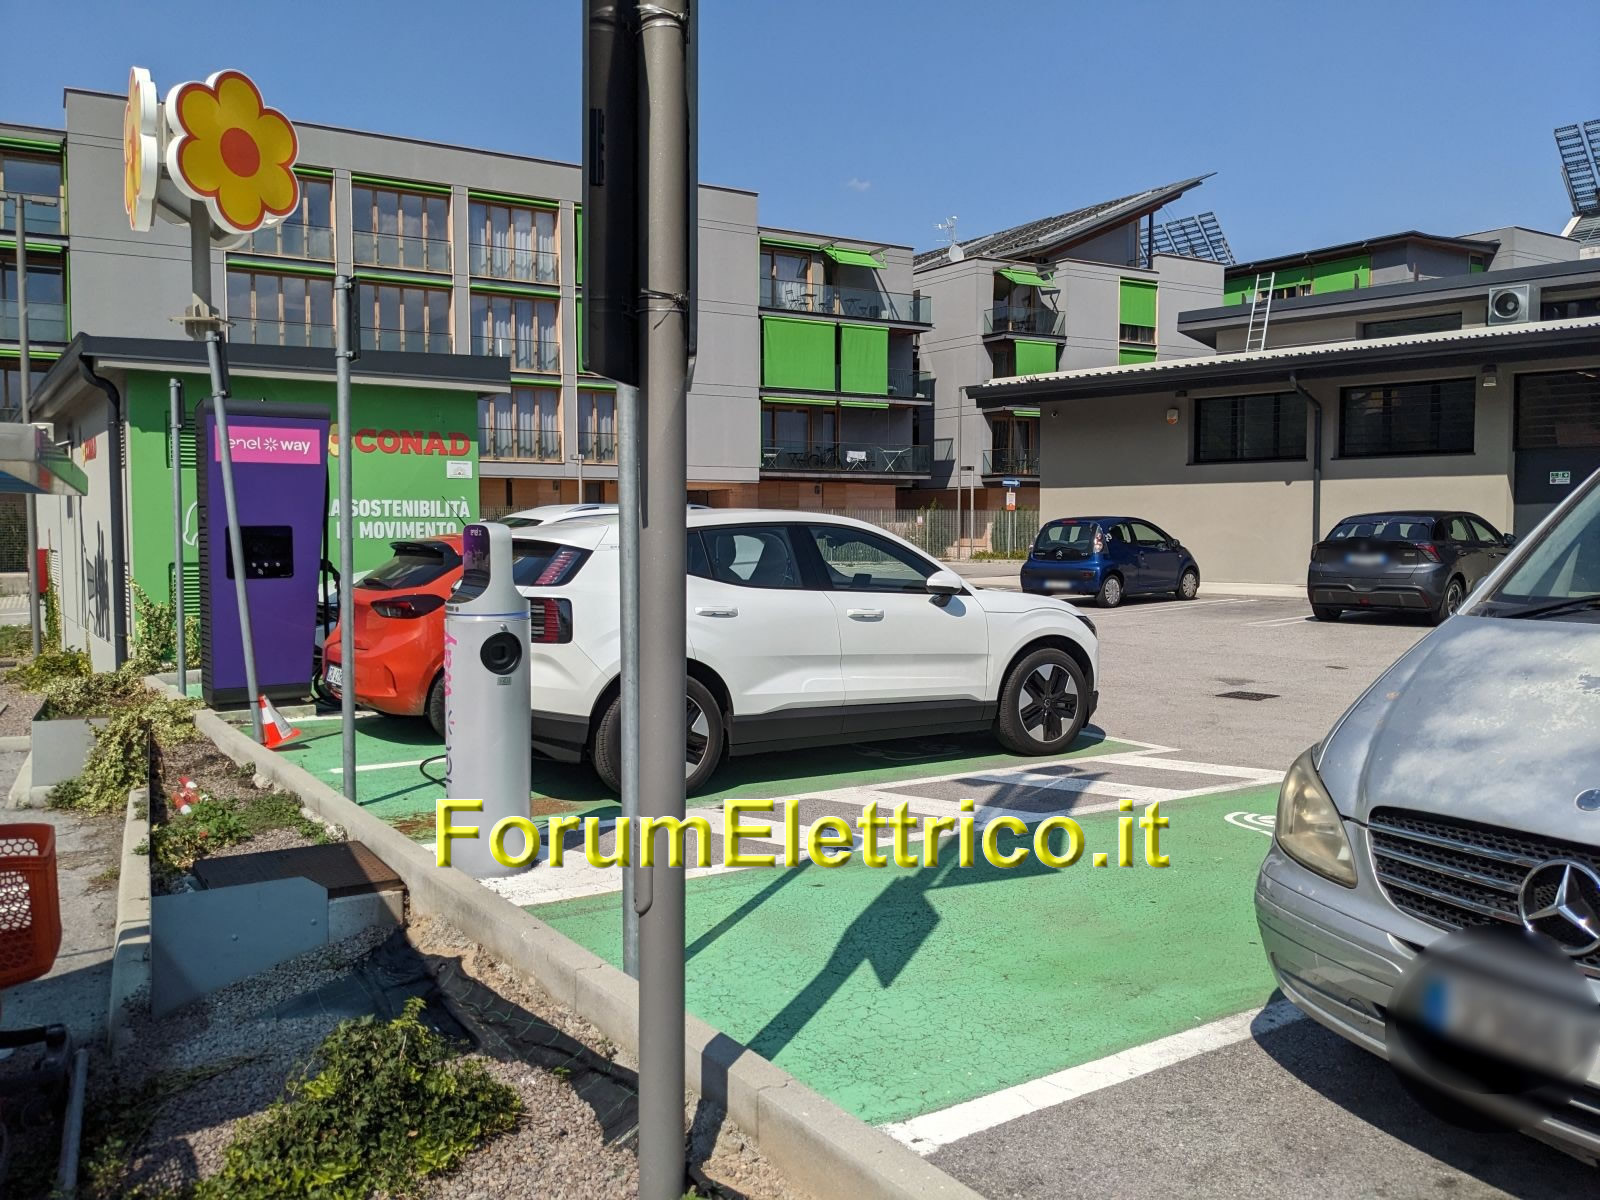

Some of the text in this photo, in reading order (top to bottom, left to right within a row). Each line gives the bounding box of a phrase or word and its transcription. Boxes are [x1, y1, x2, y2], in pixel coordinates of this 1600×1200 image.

[229, 436, 311, 455] enel way
[354, 429, 471, 457] CONAD
[351, 495, 471, 518] SOSTENIBILITÀ
[360, 521, 457, 539] MOVIMENTO
